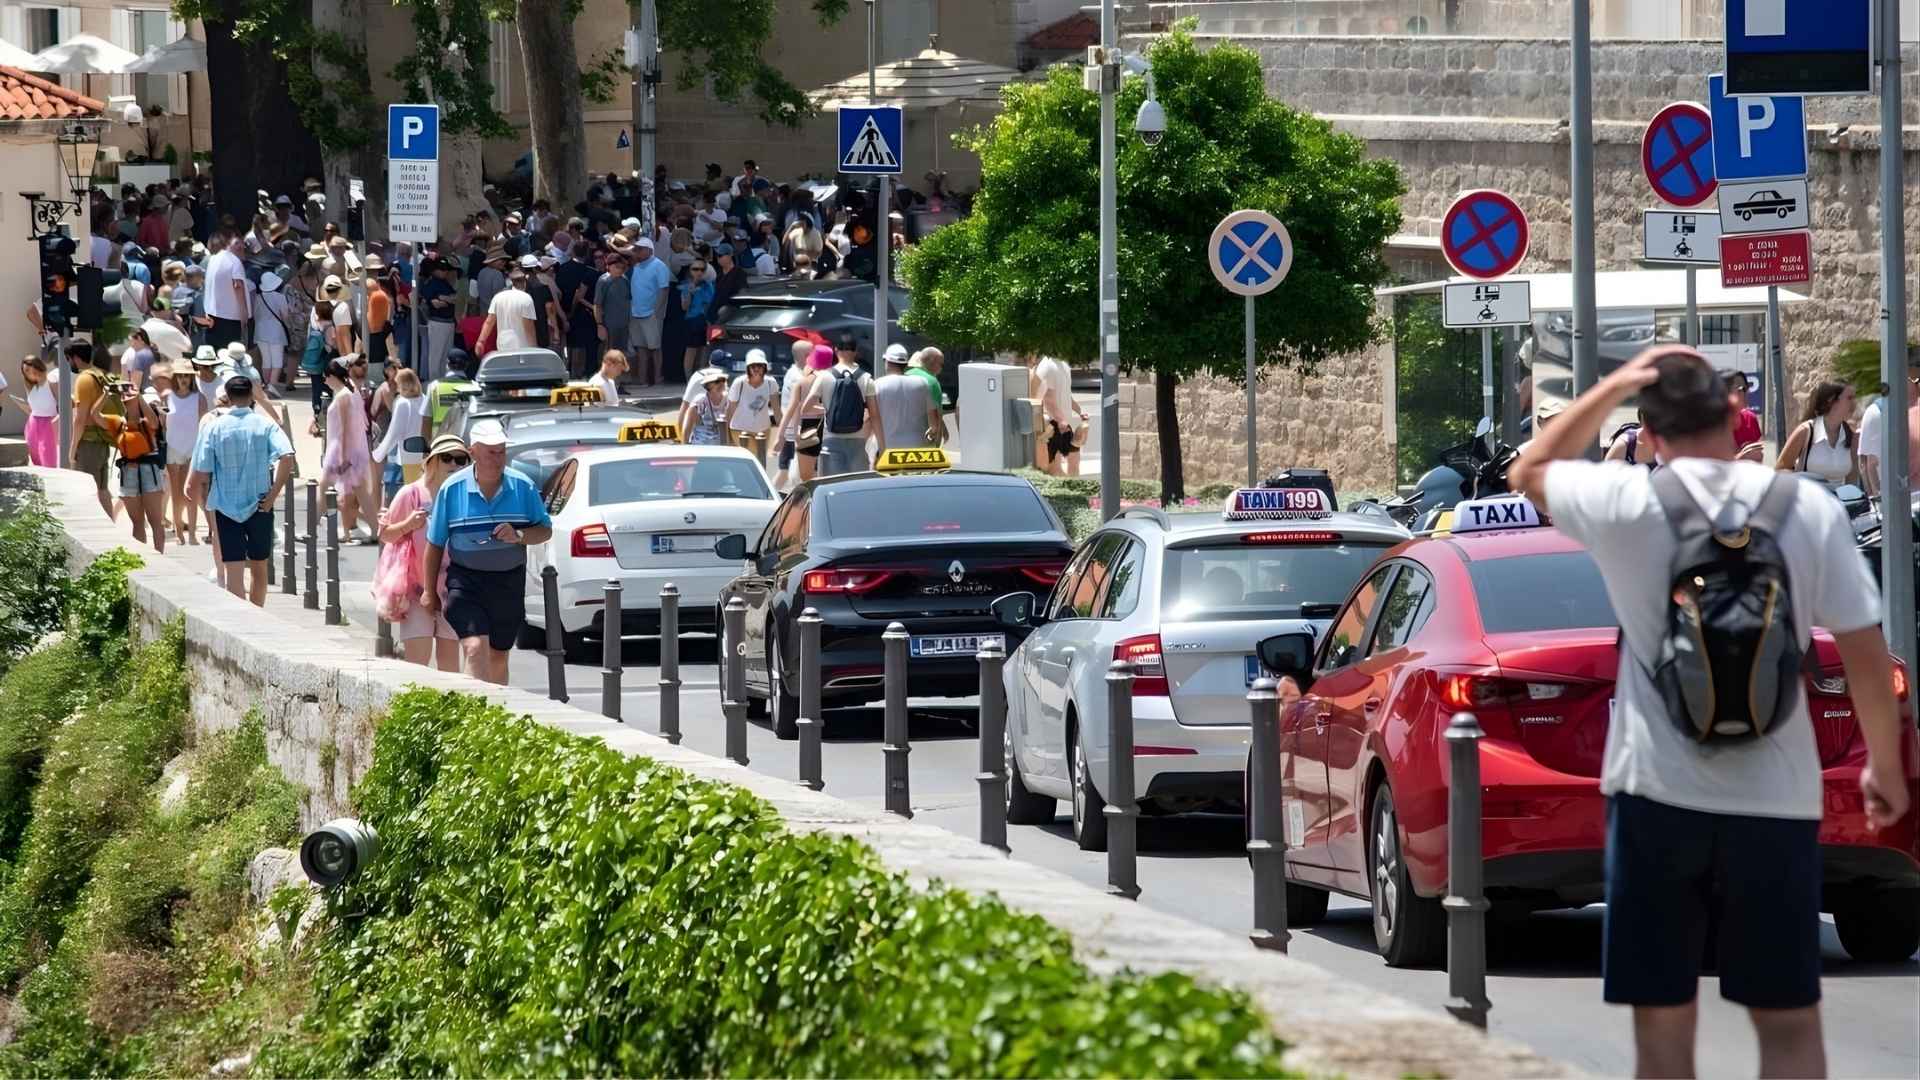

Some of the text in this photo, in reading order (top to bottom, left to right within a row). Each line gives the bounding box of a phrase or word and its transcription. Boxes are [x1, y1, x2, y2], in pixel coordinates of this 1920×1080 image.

[403, 116, 424, 149] P
[1738, 96, 1776, 158] P
[562, 391, 595, 401] TAXI
[633, 427, 671, 440] TAXI
[892, 451, 940, 463] TAXI
[1240, 491, 1318, 509] TAXI 199
[1469, 502, 1527, 525] TAXI
